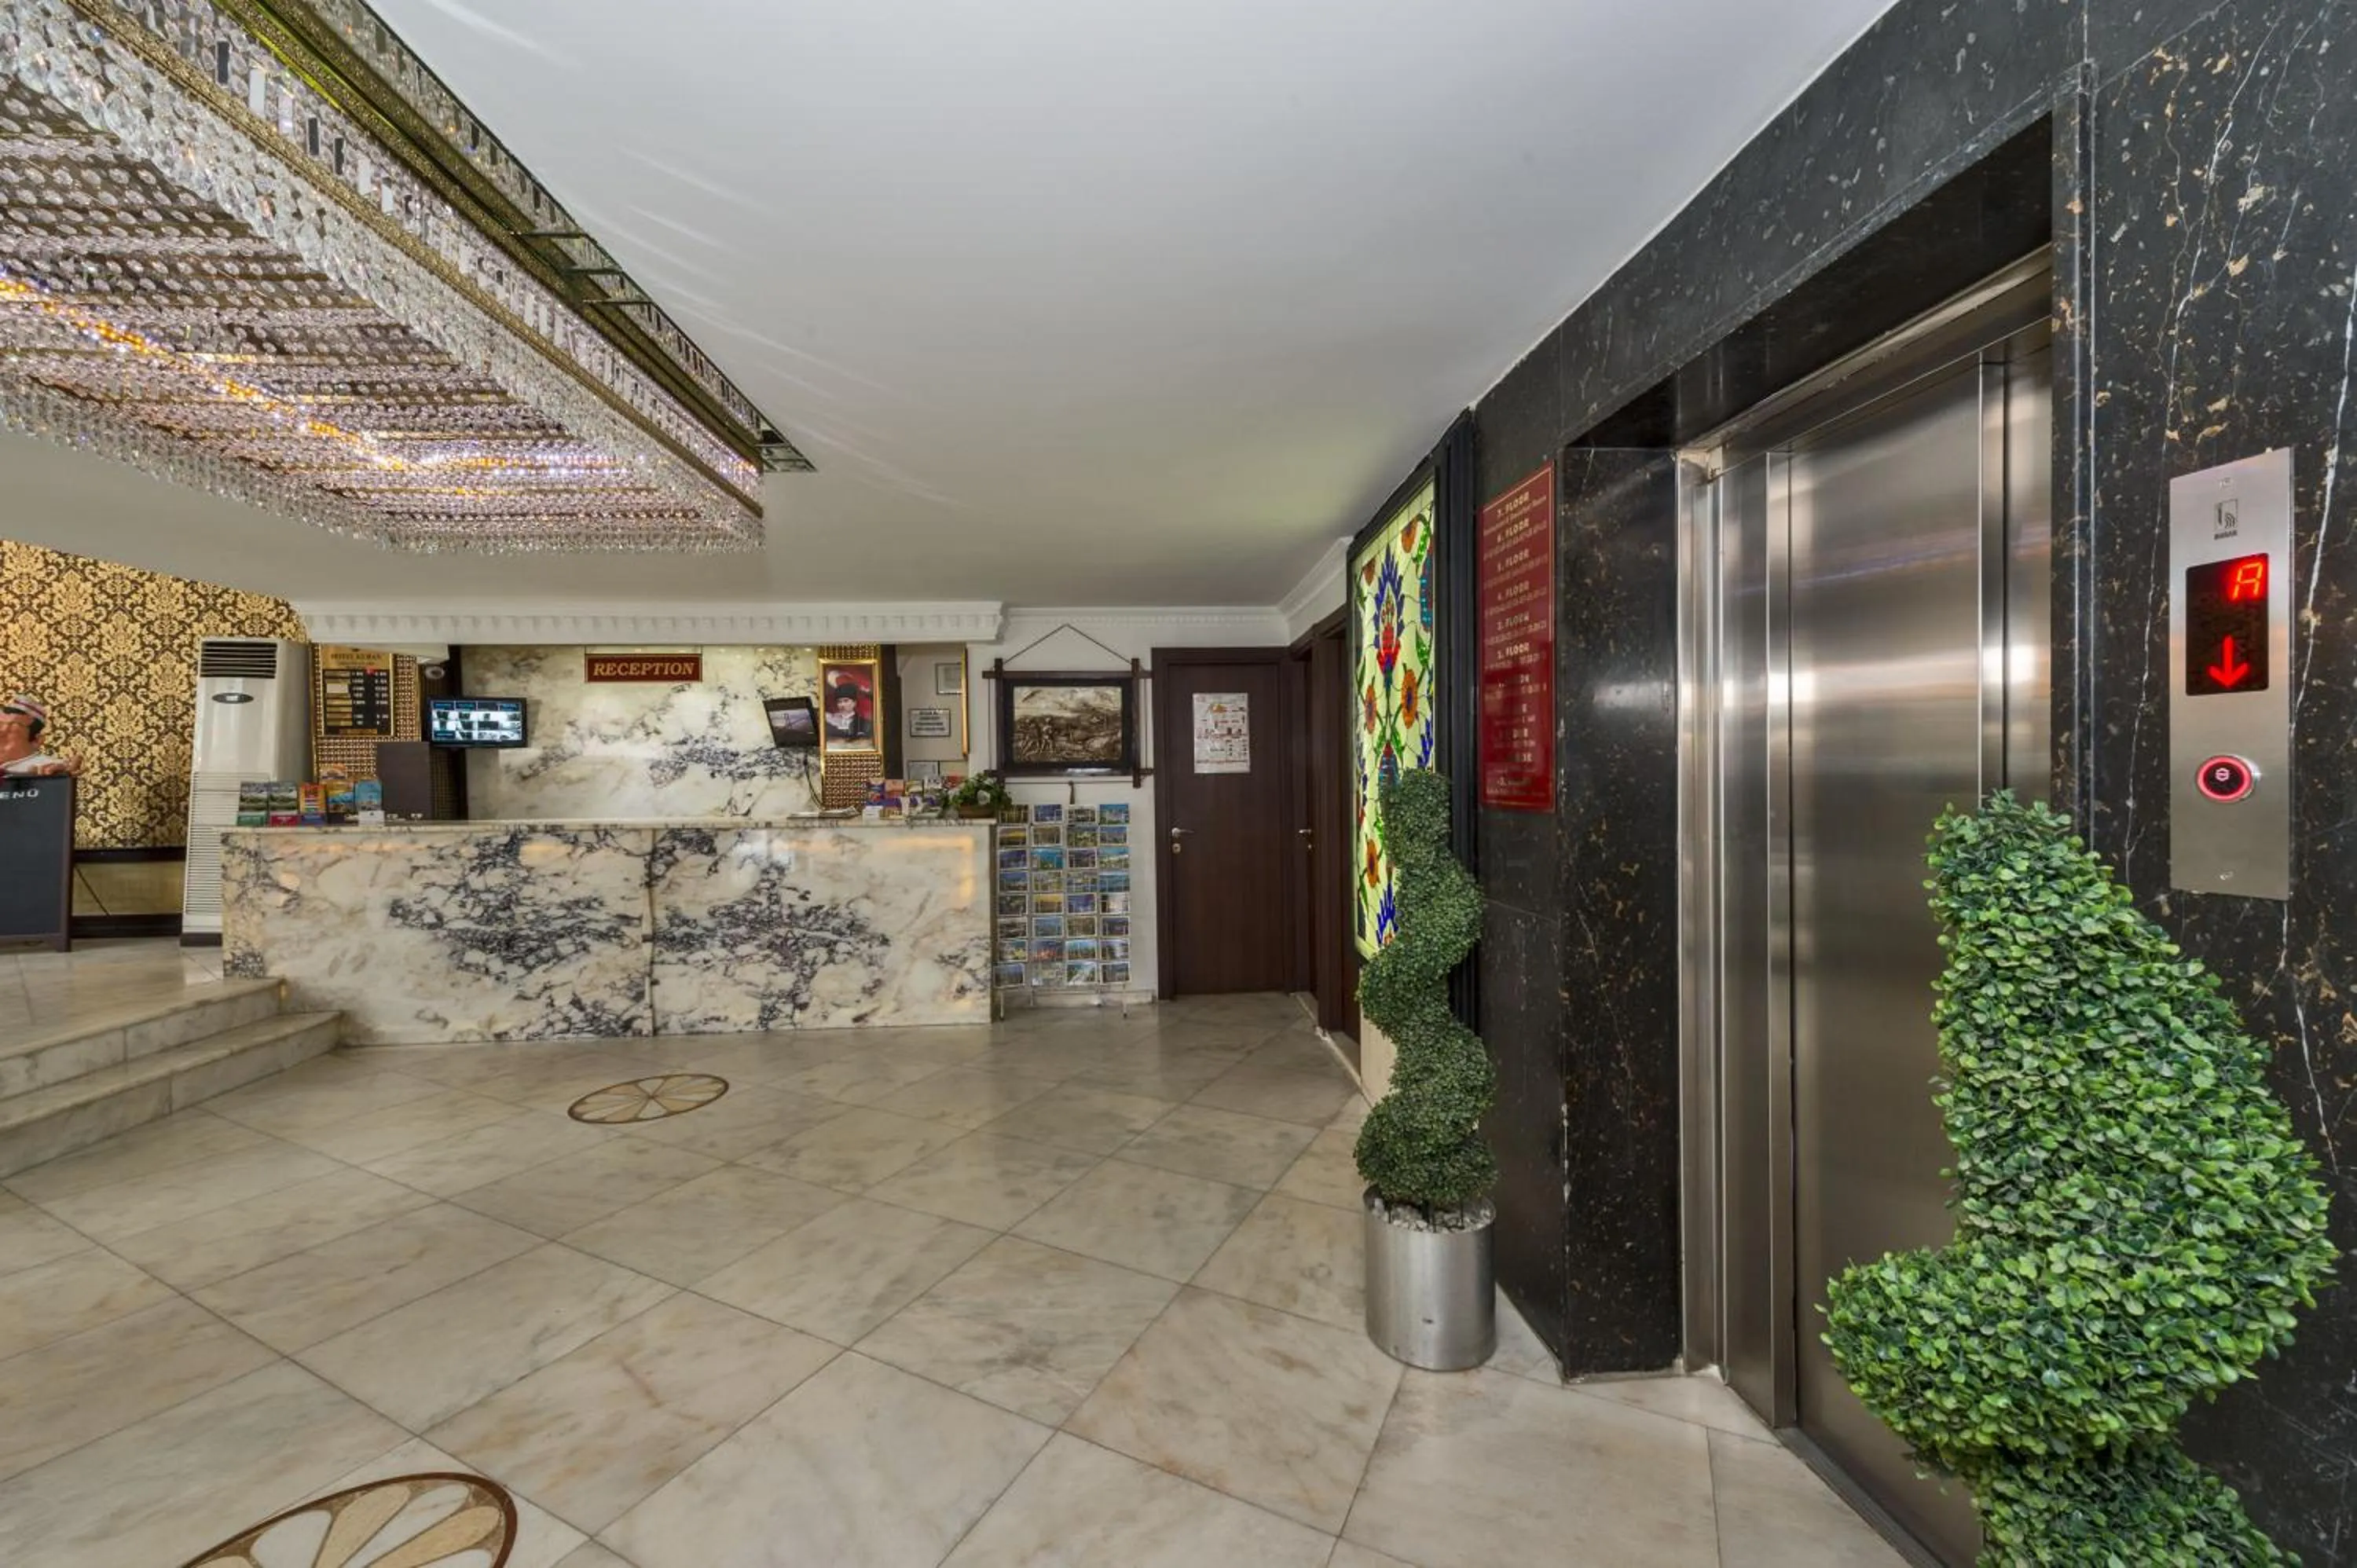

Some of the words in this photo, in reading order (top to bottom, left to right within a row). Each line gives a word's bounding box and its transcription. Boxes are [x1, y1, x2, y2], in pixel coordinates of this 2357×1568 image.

[1505, 492, 1530, 513] FLOOR
[1505, 518, 1530, 537] FLOOR
[1505, 549, 1530, 567] FLOOR
[1505, 581, 1530, 597] FLOOR
[1505, 612, 1530, 628] FLOOR
[1505, 643, 1530, 657] FLOOR
[593, 662, 694, 676] RECEPTION
[0, 788, 39, 799] ENÜ
